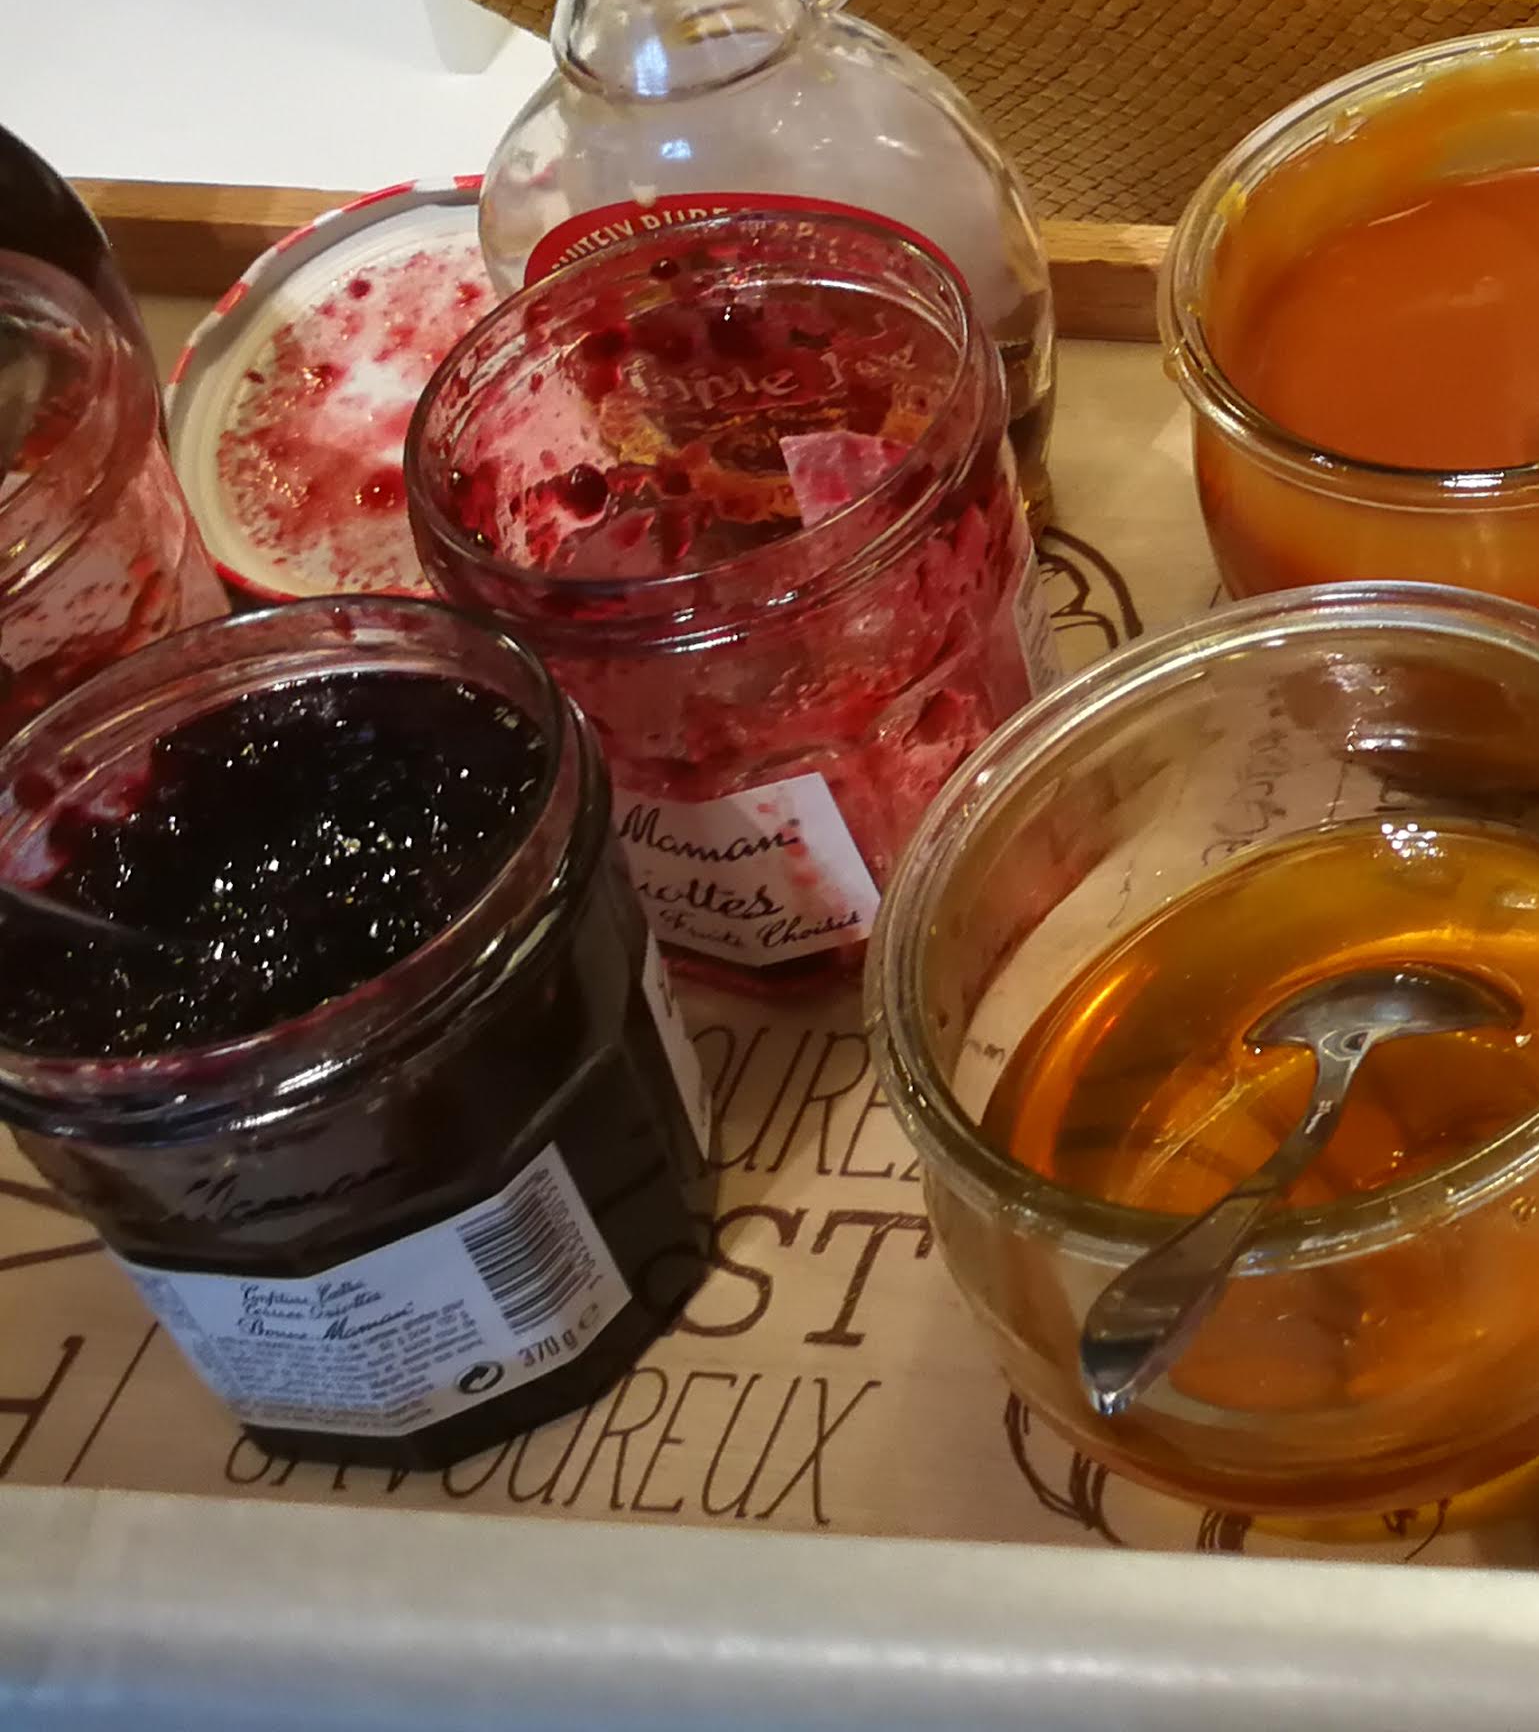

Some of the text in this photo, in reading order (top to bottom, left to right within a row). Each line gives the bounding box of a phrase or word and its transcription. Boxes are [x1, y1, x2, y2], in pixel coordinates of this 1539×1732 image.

[618, 803, 800, 862] Maman
[638, 869, 785, 920] iottes
[755, 909, 863, 948] Choisis
